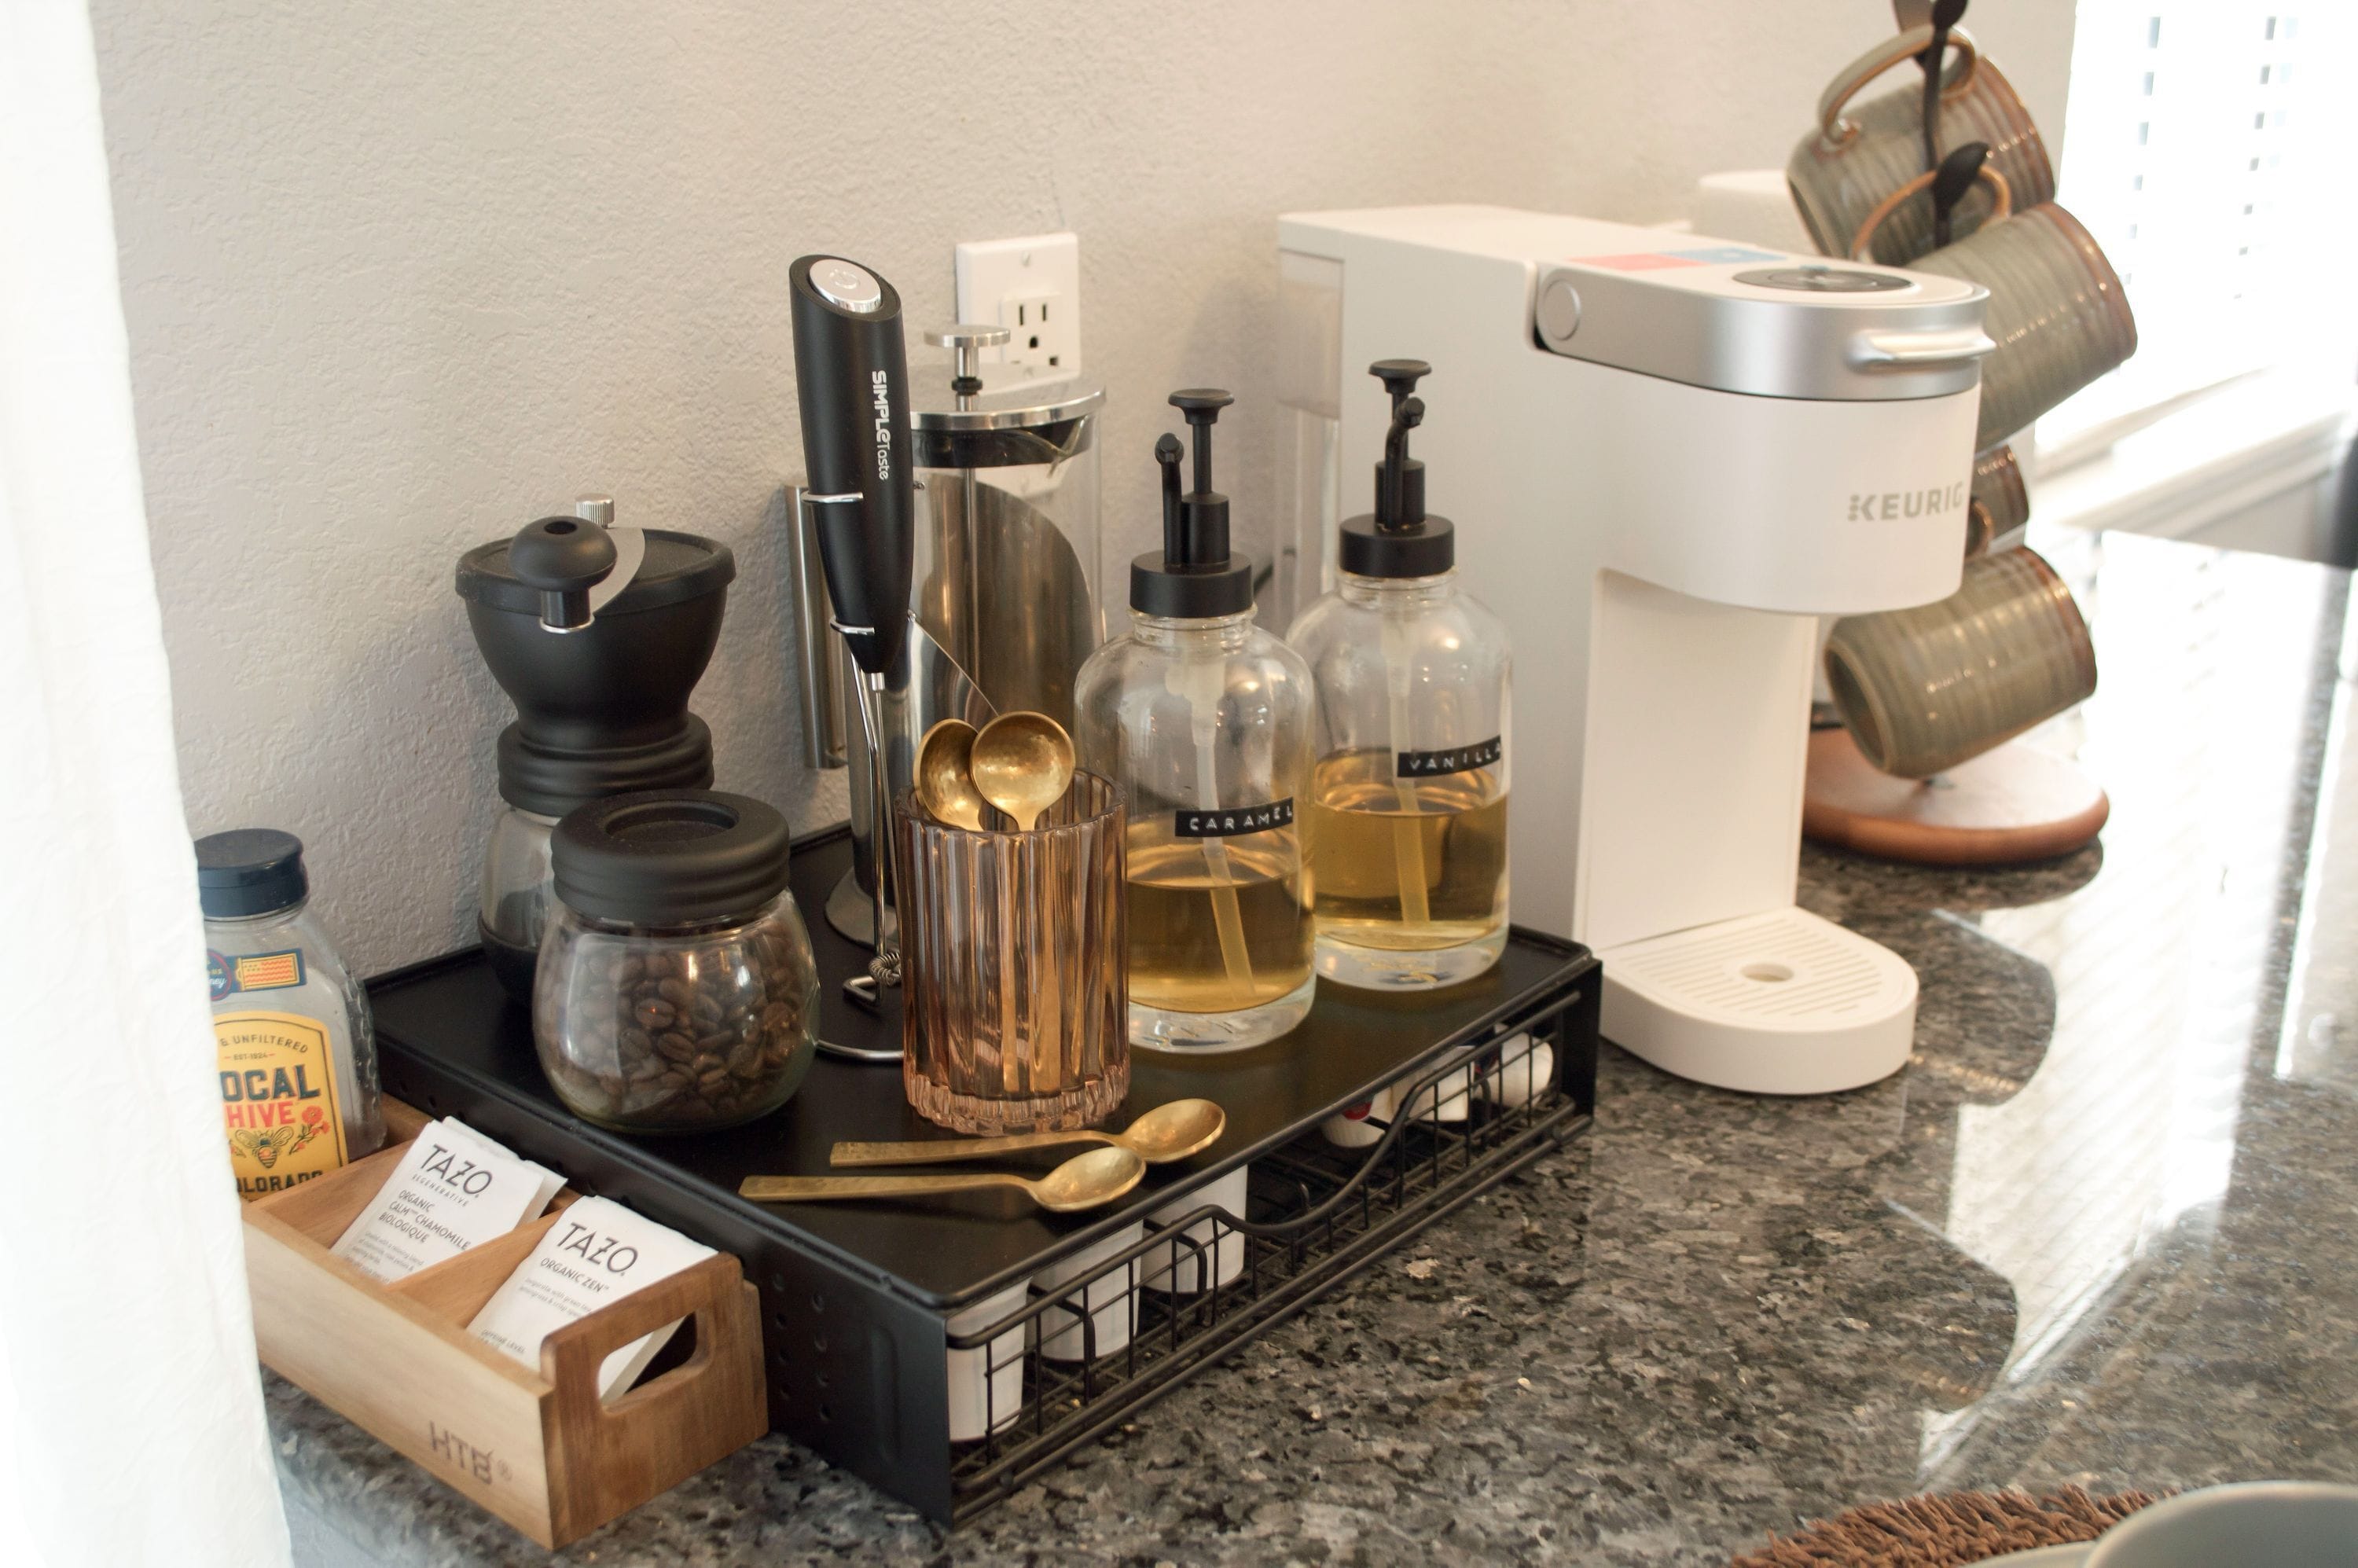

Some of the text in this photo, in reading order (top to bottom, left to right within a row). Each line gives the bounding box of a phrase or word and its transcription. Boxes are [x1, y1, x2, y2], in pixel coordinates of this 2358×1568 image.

[1847, 481, 1963, 521] KEURIG
[1189, 805, 1293, 831] CARAMEL
[232, 1034, 309, 1054] UNFILTERED
[219, 1063, 321, 1102] OCAL
[225, 1100, 296, 1129] HIVE
[420, 1144, 493, 1195] TAZO
[399, 1189, 435, 1213] ORGANIC
[379, 1211, 430, 1244] BIOLOGIQUE
[415, 1214, 472, 1250] CHAMOMILE
[556, 1221, 638, 1273] TAZO
[540, 1257, 586, 1283] ORGANIC
